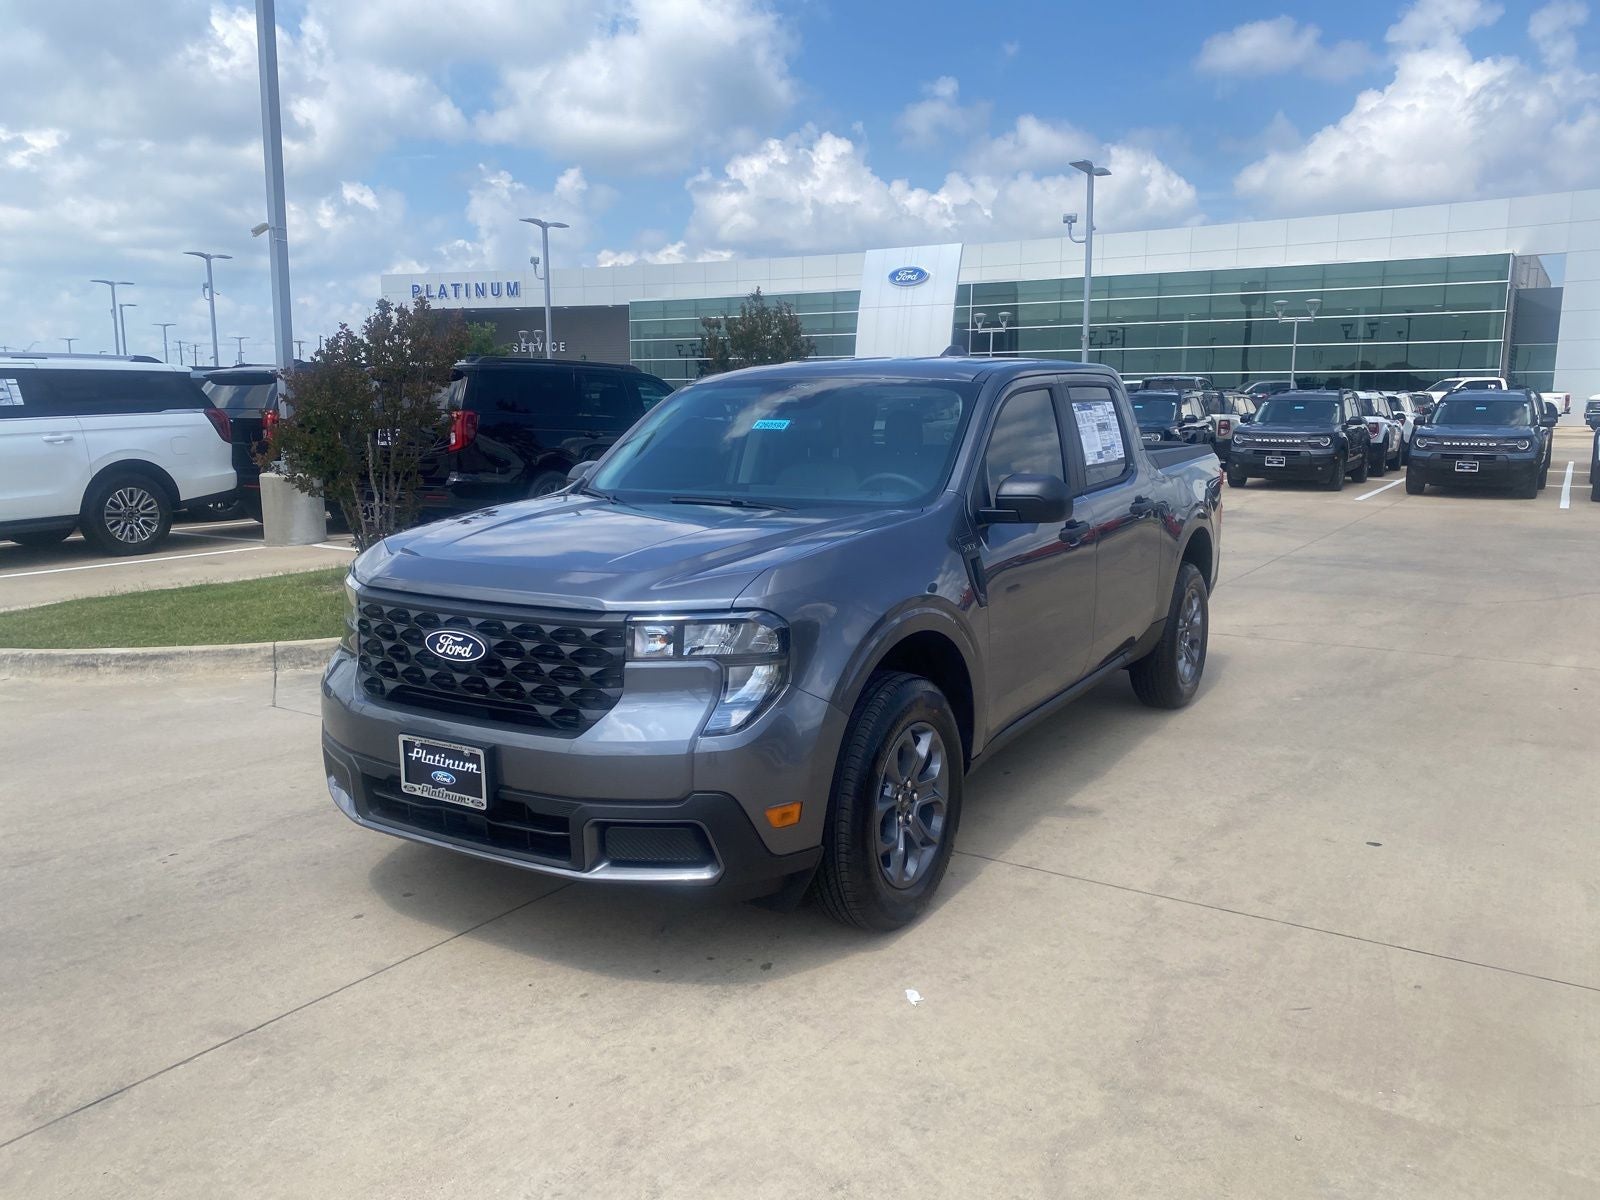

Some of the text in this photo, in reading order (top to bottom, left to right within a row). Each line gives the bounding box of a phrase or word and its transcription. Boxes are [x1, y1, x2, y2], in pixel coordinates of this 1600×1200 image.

[411, 281, 520, 299] PLATINUM
[512, 341, 566, 353] SERVCE
[436, 634, 473, 658] Ford
[408, 747, 482, 774] Platinum
[420, 784, 478, 805] Platinum
